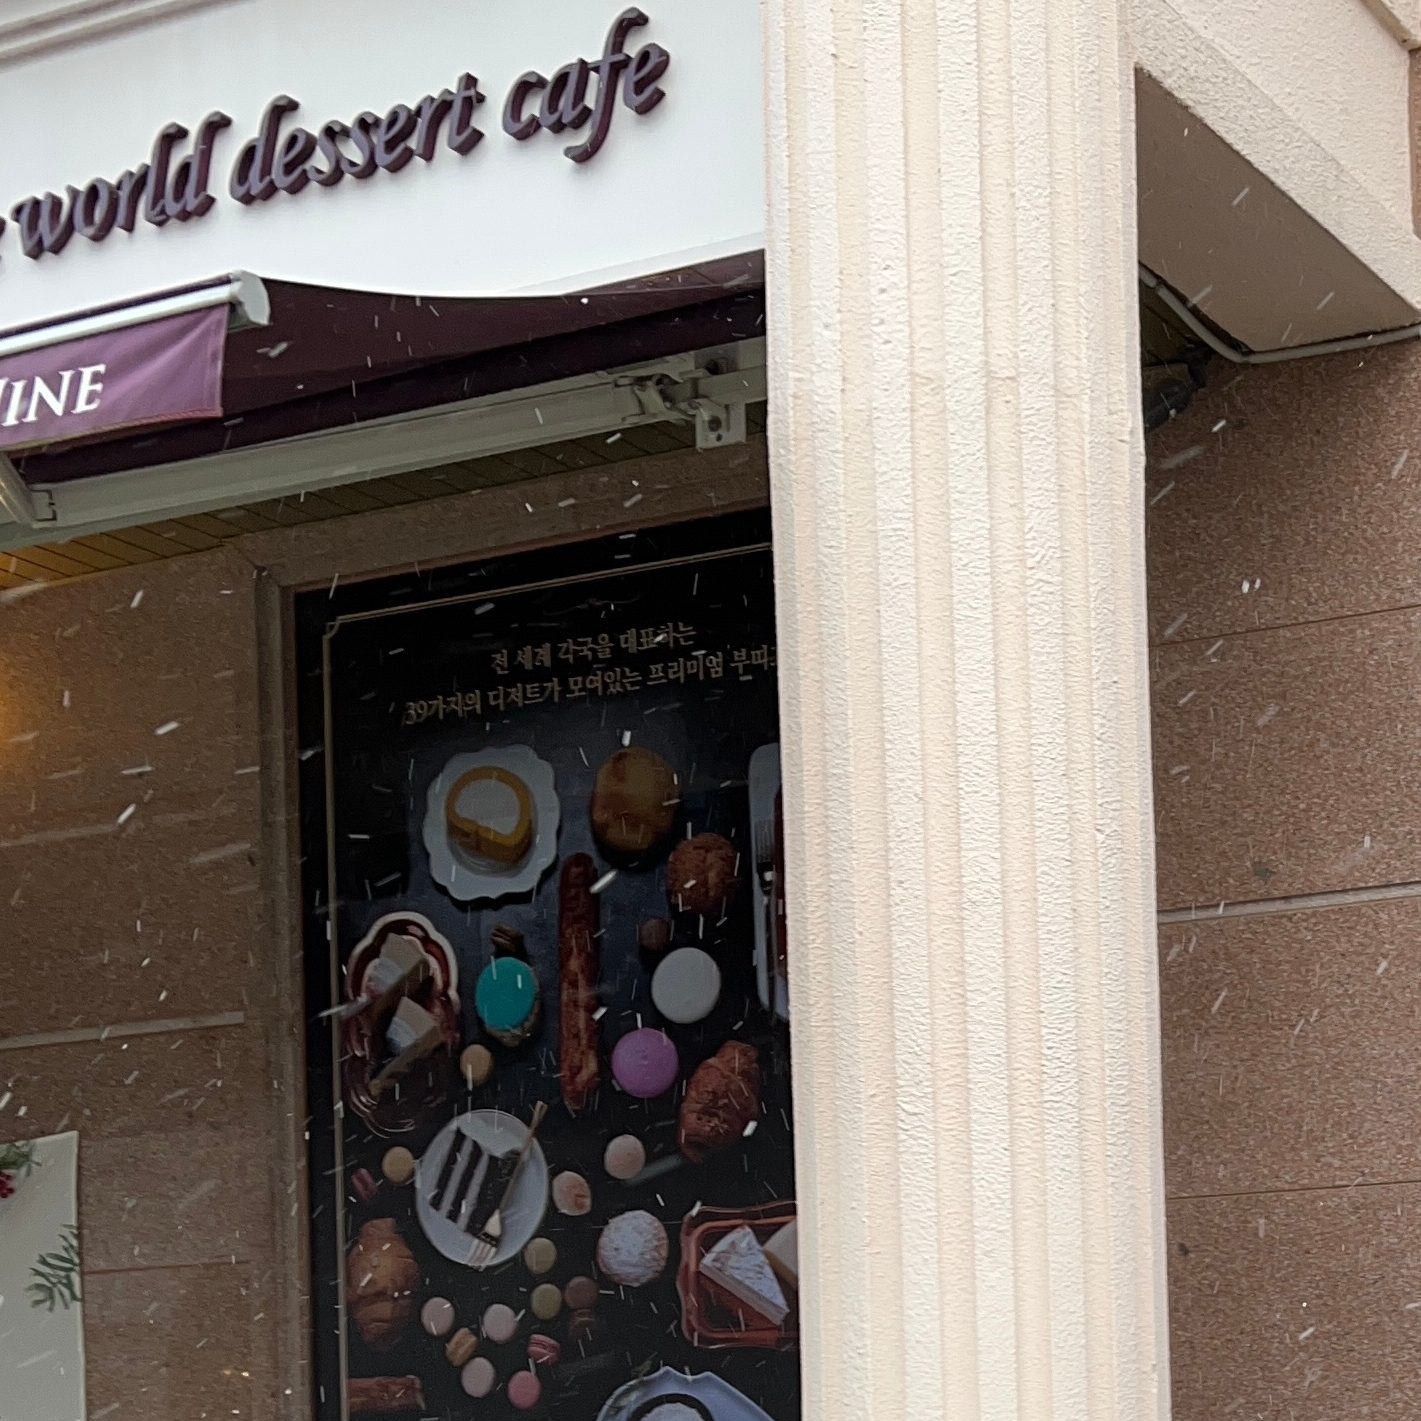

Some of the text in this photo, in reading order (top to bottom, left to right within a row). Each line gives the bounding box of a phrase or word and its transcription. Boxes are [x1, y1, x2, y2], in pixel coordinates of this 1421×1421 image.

[10, 6, 670, 260] world dessert cafe
[557, 633, 614, 665] 각국을
[619, 622, 697, 655] 대표하는
[404, 690, 481, 725] 39가지의
[566, 667, 643, 698] 모여있는
[646, 651, 723, 683] 프리미엄
